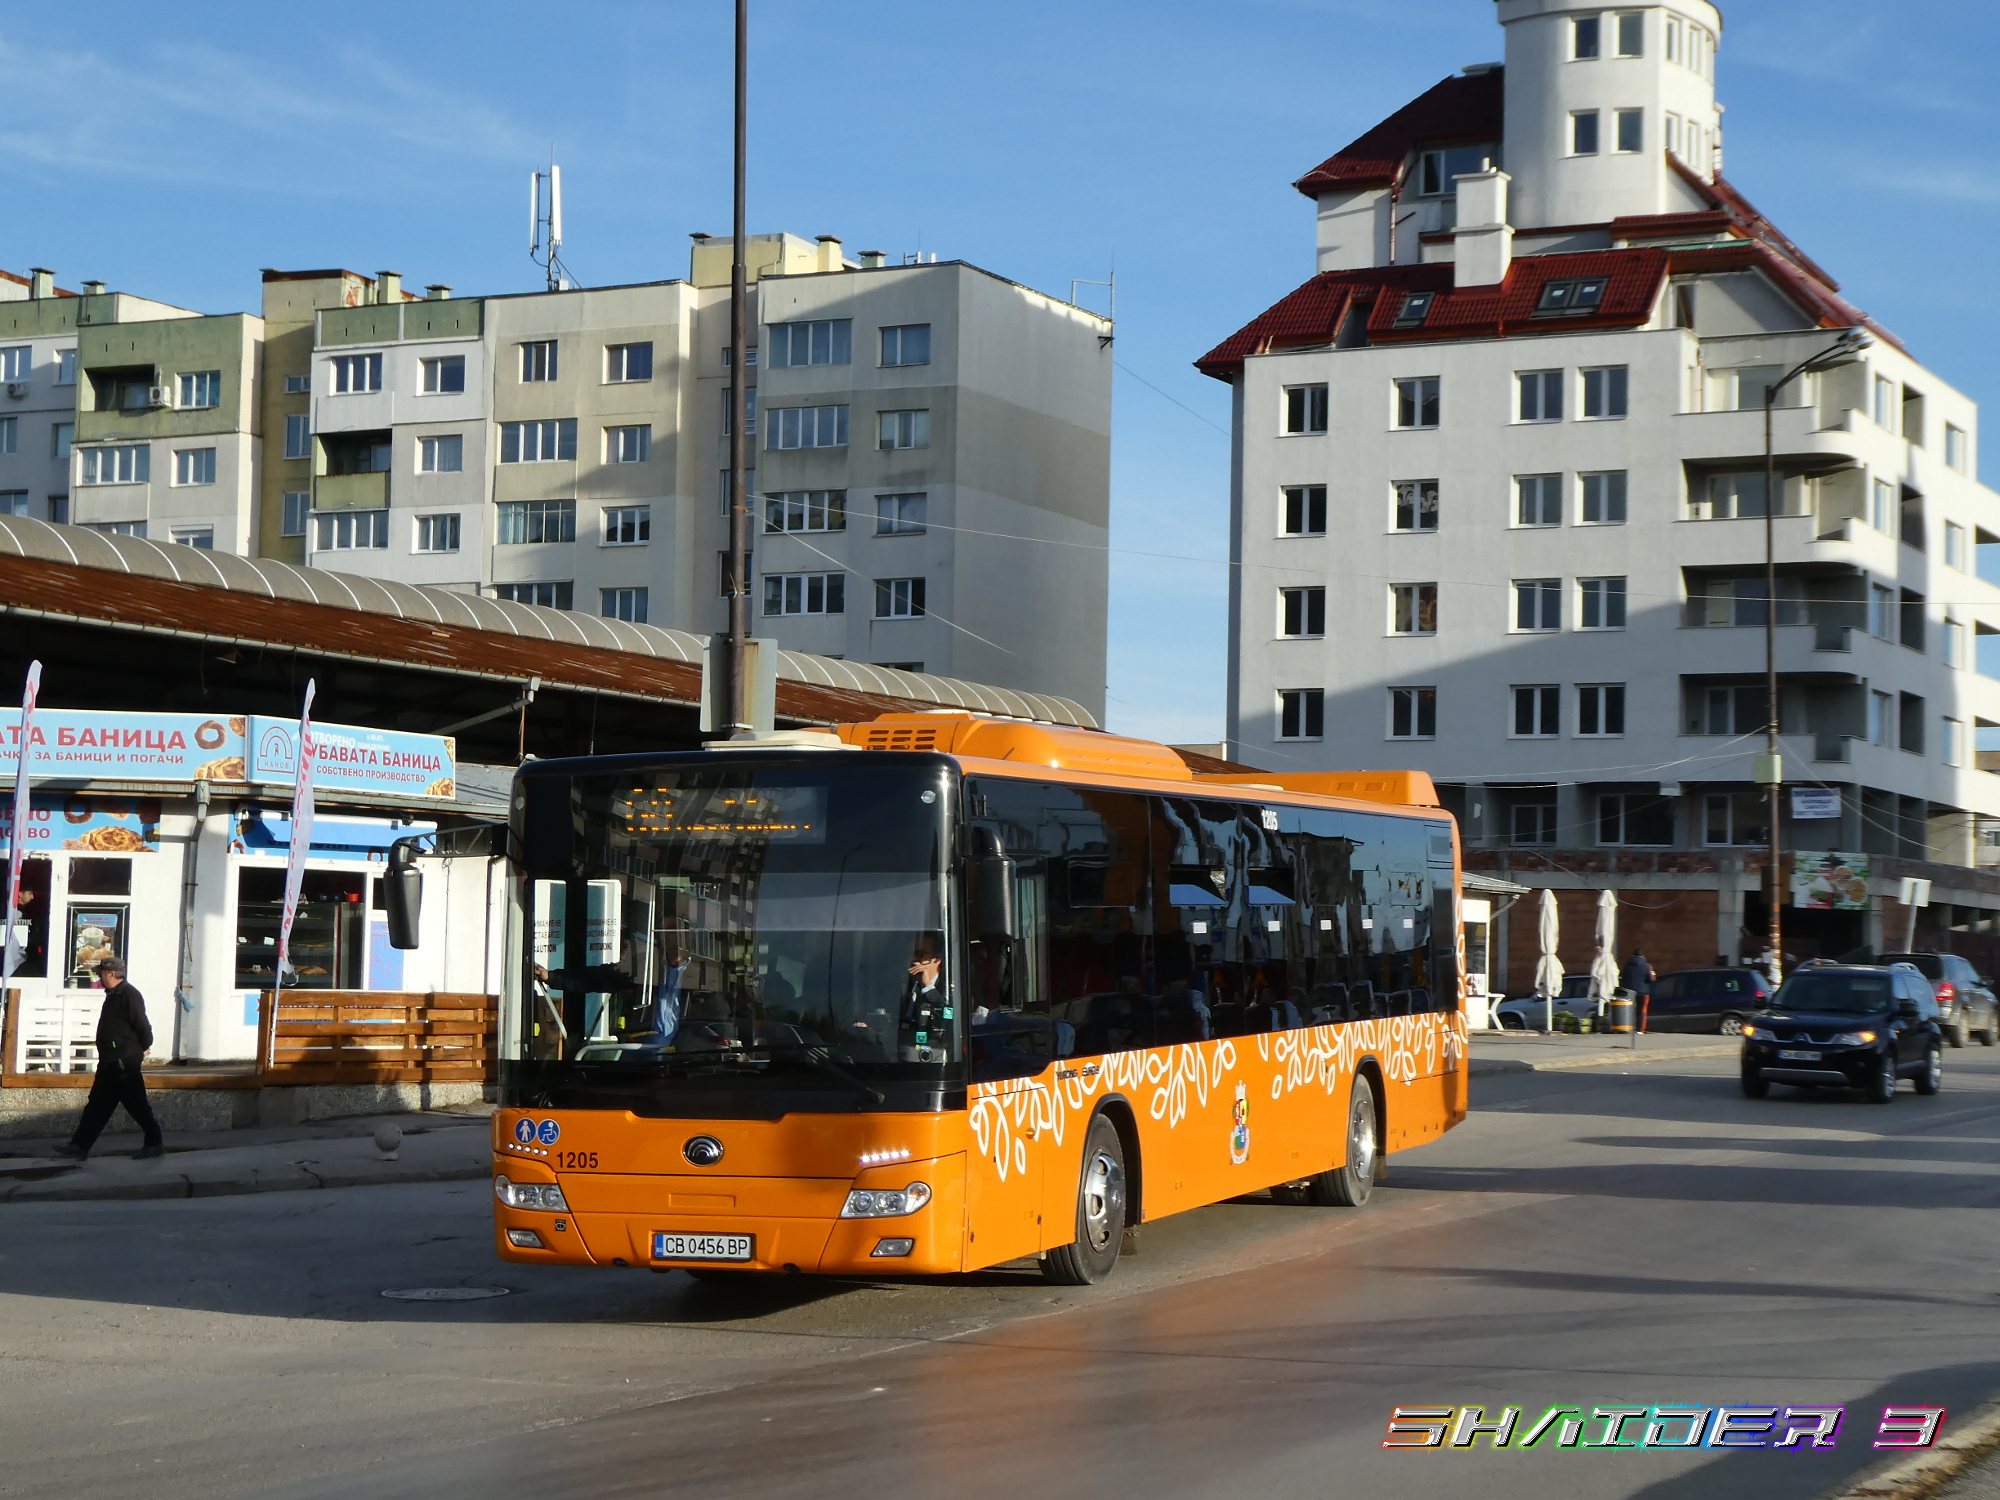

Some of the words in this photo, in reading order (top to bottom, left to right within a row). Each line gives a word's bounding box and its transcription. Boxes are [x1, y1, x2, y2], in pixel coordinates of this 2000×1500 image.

[57, 726, 187, 752] БАНИЦА
[34, 751, 52, 761] ЗА
[56, 751, 112, 763] БАНИЦИ
[117, 753, 126, 763] И
[130, 753, 184, 764] ПОГАЧИ
[311, 744, 378, 765] УБАВАТА
[382, 751, 442, 773] БАНИЦА
[316, 765, 364, 778] СОБСТВЕНО
[365, 769, 426, 783] ПРОИЗВОДСТВО
[1261, 809, 1278, 831] 1205
[556, 1151, 599, 1169] 1205
[665, 1237, 685, 1254] CB
[688, 1238, 725, 1255] 0456
[728, 1238, 748, 1255] BP
